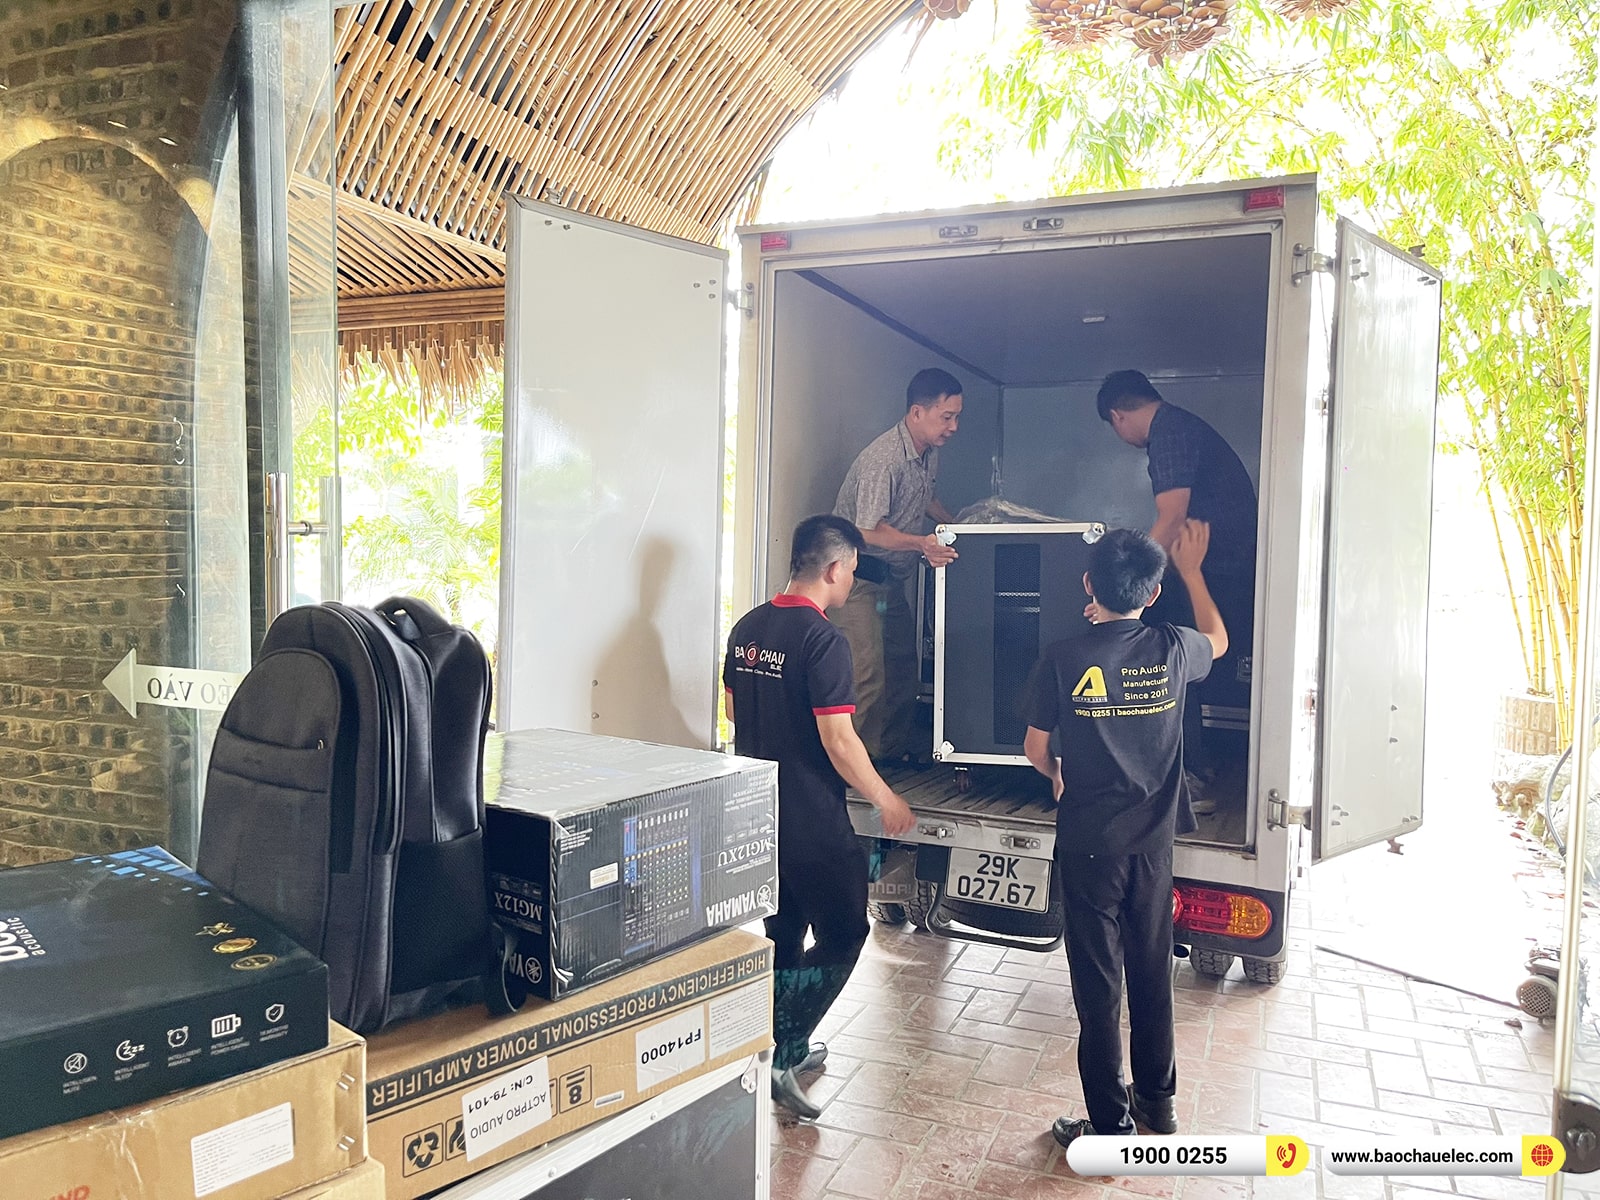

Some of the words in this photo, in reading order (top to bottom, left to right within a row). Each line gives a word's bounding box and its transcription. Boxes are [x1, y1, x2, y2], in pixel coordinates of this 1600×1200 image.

[759, 649, 785, 665] CHAU
[1121, 668, 1138, 676] Pro
[1139, 664, 1167, 675] Audio
[1124, 692, 1149, 701] Since
[1150, 688, 1168, 698] 2011
[1091, 709, 1111, 718] 0255
[718, 837, 773, 868] MG12XU
[976, 853, 1019, 880] 29K
[957, 875, 1036, 908] 027.67
[706, 890, 756, 927] YAMAHA
[7, 917, 46, 956] acoustic
[737, 953, 766, 978] HIGH
[659, 963, 735, 1005] EFFICIENCY
[541, 996, 656, 1044] PROFESSIONAL
[477, 1033, 538, 1069] POWER
[641, 1028, 701, 1065] FP14000
[372, 1053, 473, 1107] AMPLIFIER
[510, 1075, 533, 1092] C/N:
[468, 1087, 508, 1114] 79-101
[506, 1091, 547, 1122] ACTPRO
[470, 1112, 504, 1139] AUDIO
